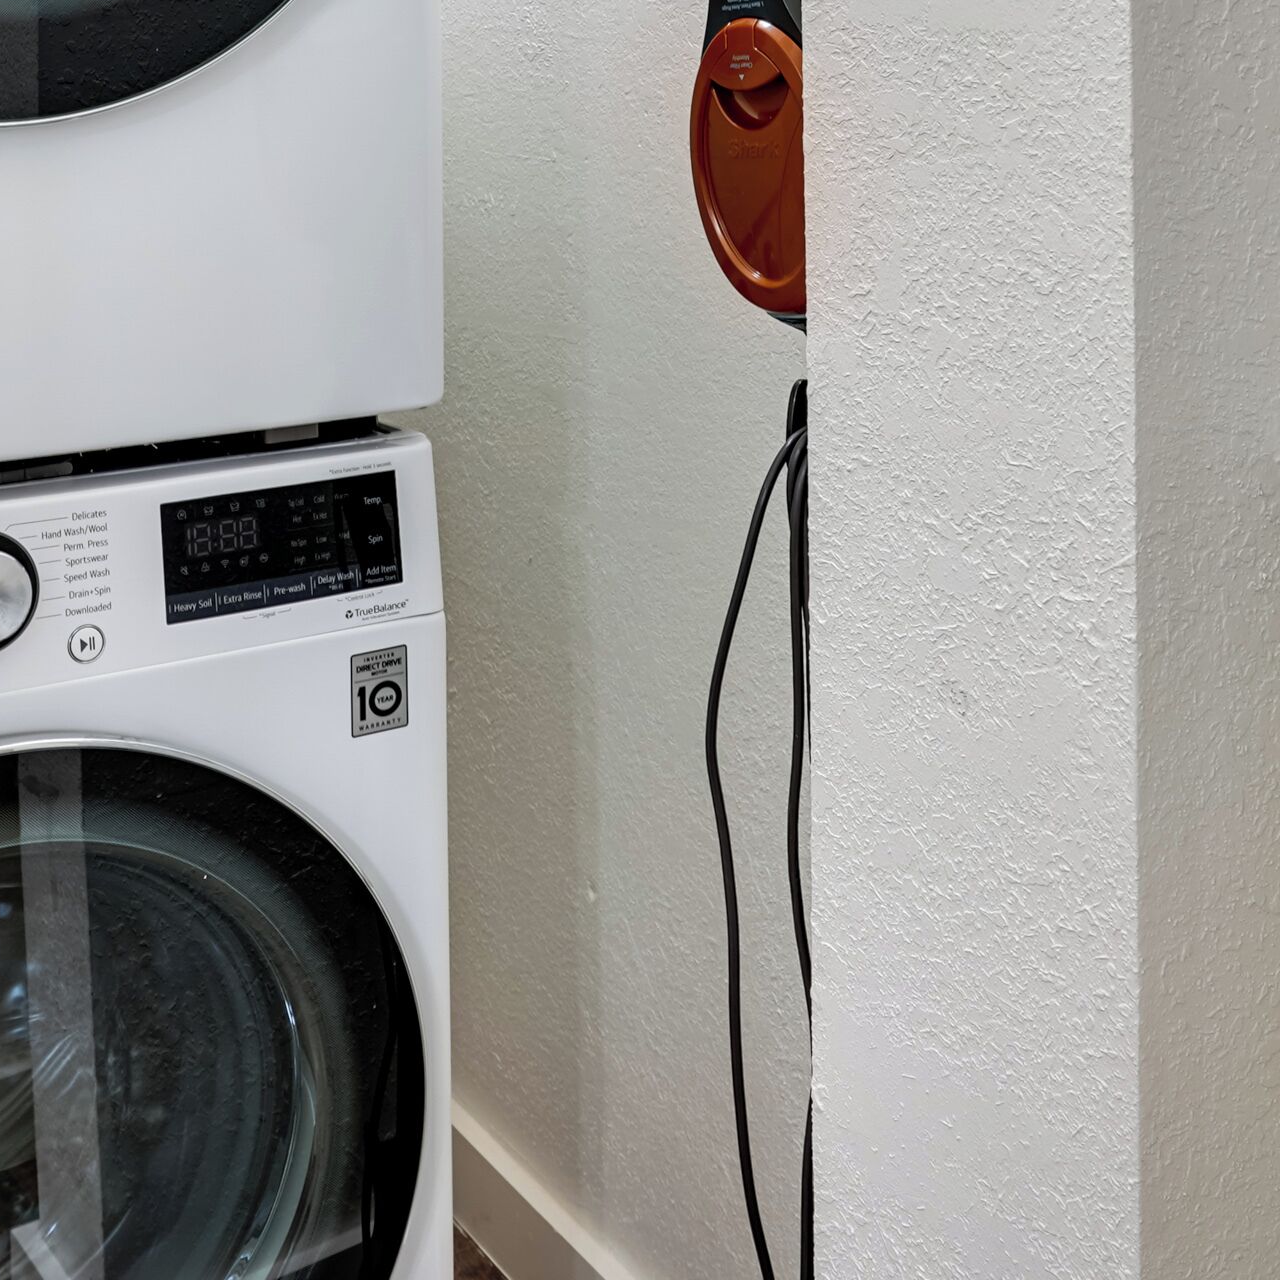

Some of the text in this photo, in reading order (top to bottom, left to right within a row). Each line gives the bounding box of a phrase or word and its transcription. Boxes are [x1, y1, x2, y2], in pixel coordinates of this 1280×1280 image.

[71, 510, 107, 521] Delicates
[41, 522, 108, 540] Hand Wash/Wool
[87, 539, 109, 549] Press
[367, 533, 384, 545] Spin
[65, 554, 109, 568] Sportswear
[63, 567, 111, 583] Speed Wash
[366, 563, 397, 577] Add Item
[317, 570, 355, 586] Delay Wash
[68, 585, 111, 599] Drain+Spin
[273, 582, 306, 596] Pre-wash
[223, 590, 262, 605] Extra Rinse
[65, 601, 112, 617] Downloaded
[173, 598, 213, 614] Heavy Soil
[363, 651, 395, 663] INVERTER
[355, 656, 402, 674] DIRECT DRIVE
[357, 680, 402, 722] 10 YEAR
[358, 716, 401, 731] WARRANTY
